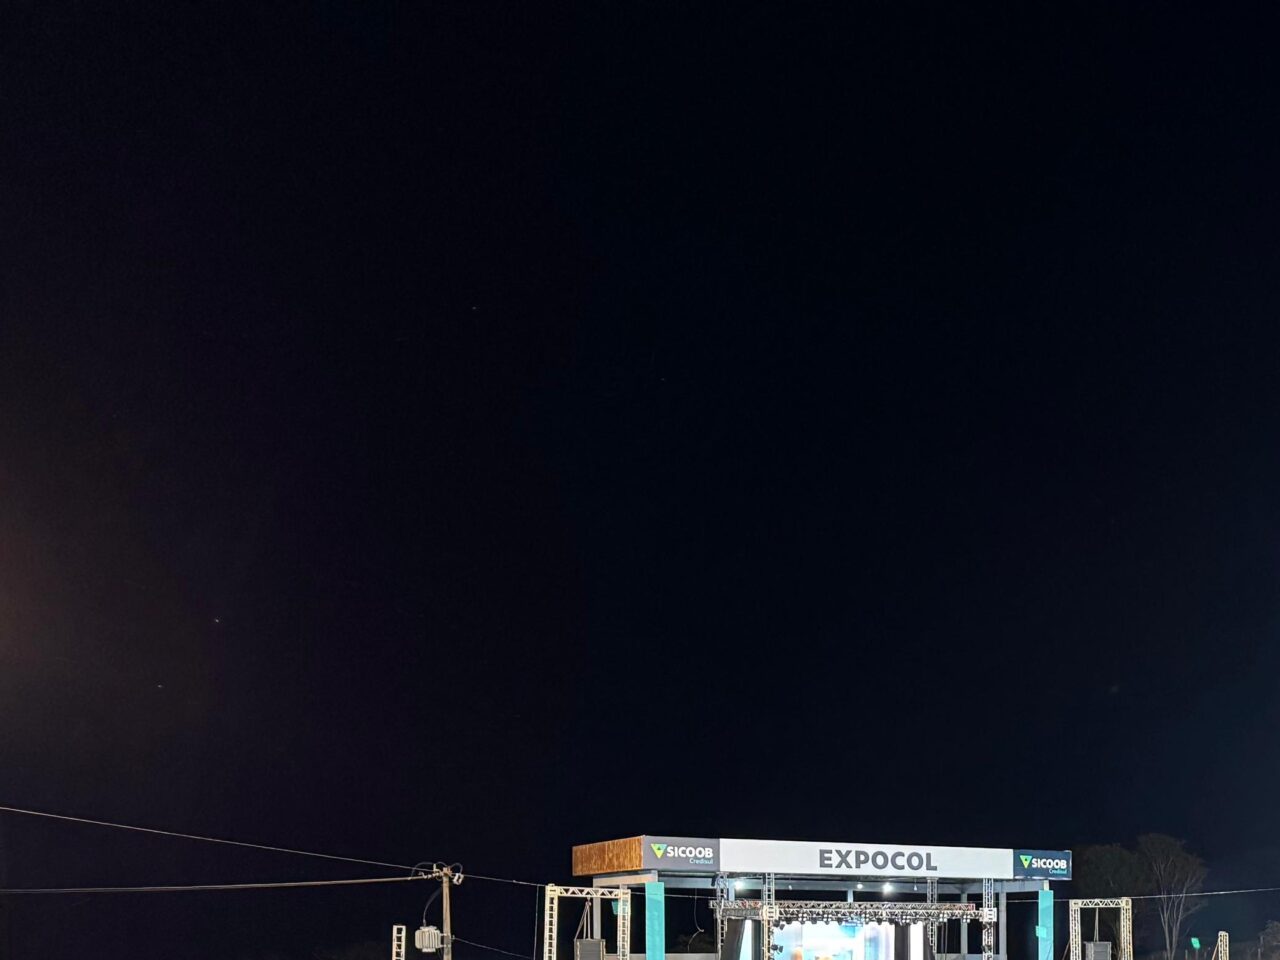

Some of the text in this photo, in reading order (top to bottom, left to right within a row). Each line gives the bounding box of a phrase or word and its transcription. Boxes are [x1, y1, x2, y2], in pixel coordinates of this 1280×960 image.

[666, 846, 713, 858] SICOOB
[818, 849, 938, 871] EXPOCOL
[1031, 858, 1067, 869] SICOOB
